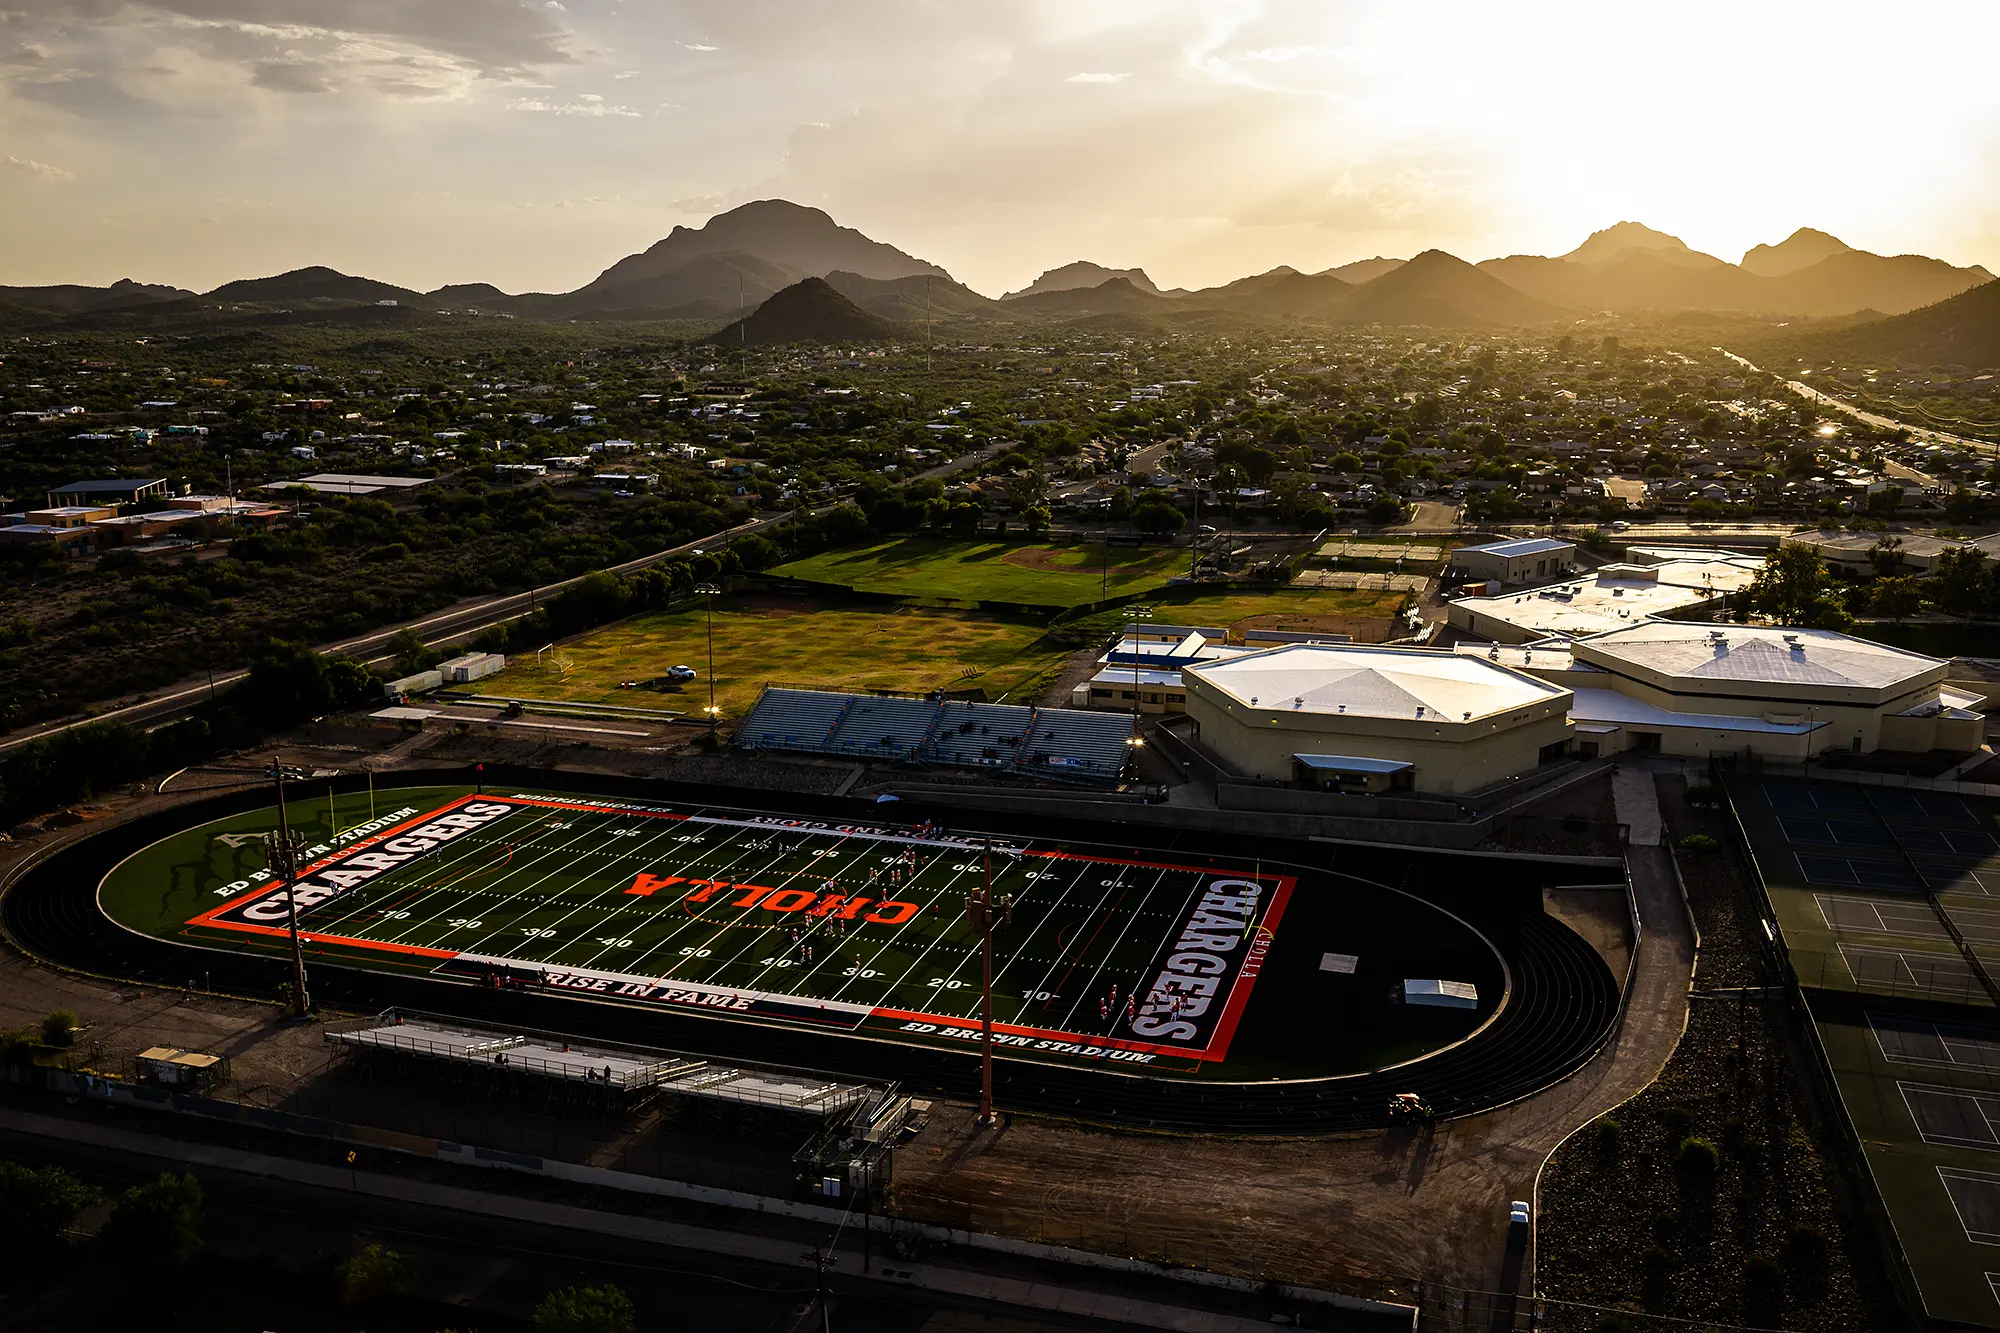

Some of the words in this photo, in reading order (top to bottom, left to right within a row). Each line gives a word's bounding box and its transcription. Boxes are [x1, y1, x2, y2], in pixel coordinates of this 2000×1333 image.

[749, 815, 828, 830] GLORY
[834, 823, 892, 836] AND
[213, 880, 250, 898] ED
[329, 806, 420, 846] STADIUM
[311, 835, 388, 869] CHOLLA
[811, 849, 840, 859] 50
[241, 803, 512, 920] CHARGERS
[951, 864, 981, 874] 30
[1025, 871, 1056, 881] 20
[1100, 879, 1129, 889] 10
[621, 872, 921, 925] CHOLLA
[383, 910, 411, 921] 10
[450, 918, 483, 929] 20
[523, 927, 558, 939] 30
[600, 936, 634, 948] 40
[678, 946, 713, 959] 50
[1241, 932, 1274, 978] CHOLLA
[759, 957, 793, 969] 40
[1132, 879, 1263, 1041] CHARGERS
[842, 966, 878, 979] 30
[926, 977, 963, 990] 20
[546, 972, 613, 991] RISE
[614, 983, 656, 999] IN
[658, 986, 756, 1011] FAME
[1020, 989, 1051, 1001] 10
[899, 1021, 937, 1034] ED
[1034, 1039, 1157, 1064] STADIUM
